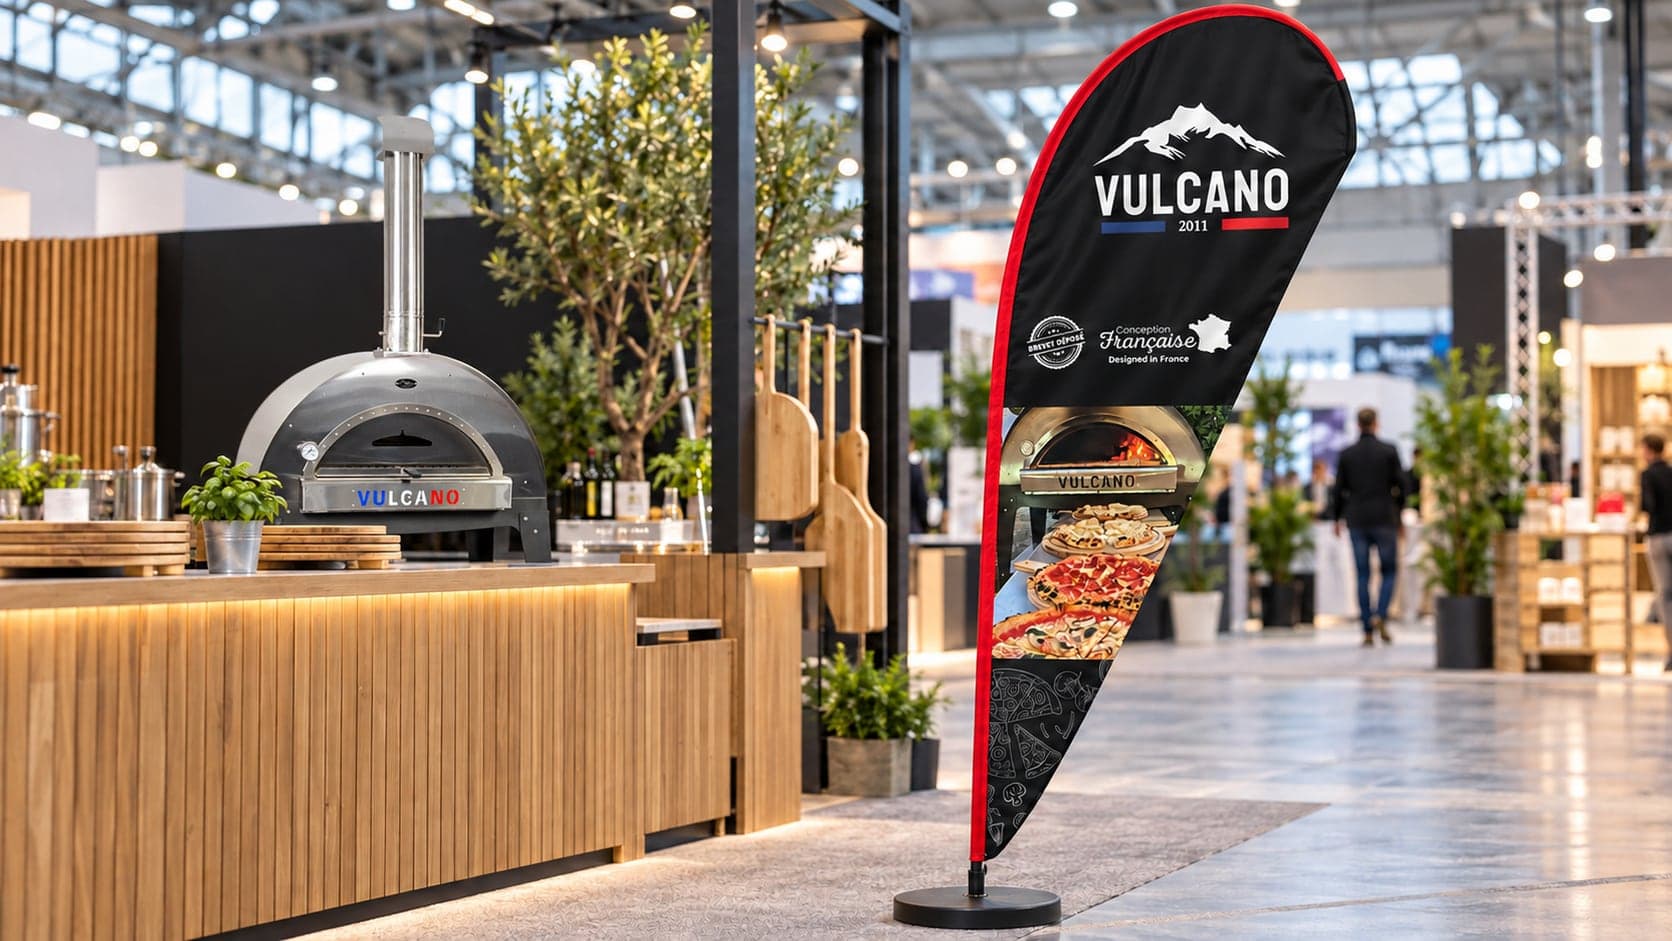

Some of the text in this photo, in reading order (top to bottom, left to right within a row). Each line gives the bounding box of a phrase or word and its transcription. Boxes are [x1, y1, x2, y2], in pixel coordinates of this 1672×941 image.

[1094, 168, 1290, 217] VULCANO
[1178, 220, 1209, 232] 2011
[1115, 325, 1171, 336] Conception
[1099, 329, 1197, 354] Française
[1108, 355, 1190, 365] Designed in France
[1058, 474, 1136, 489] VULCANO
[357, 489, 461, 507] VULCANO
